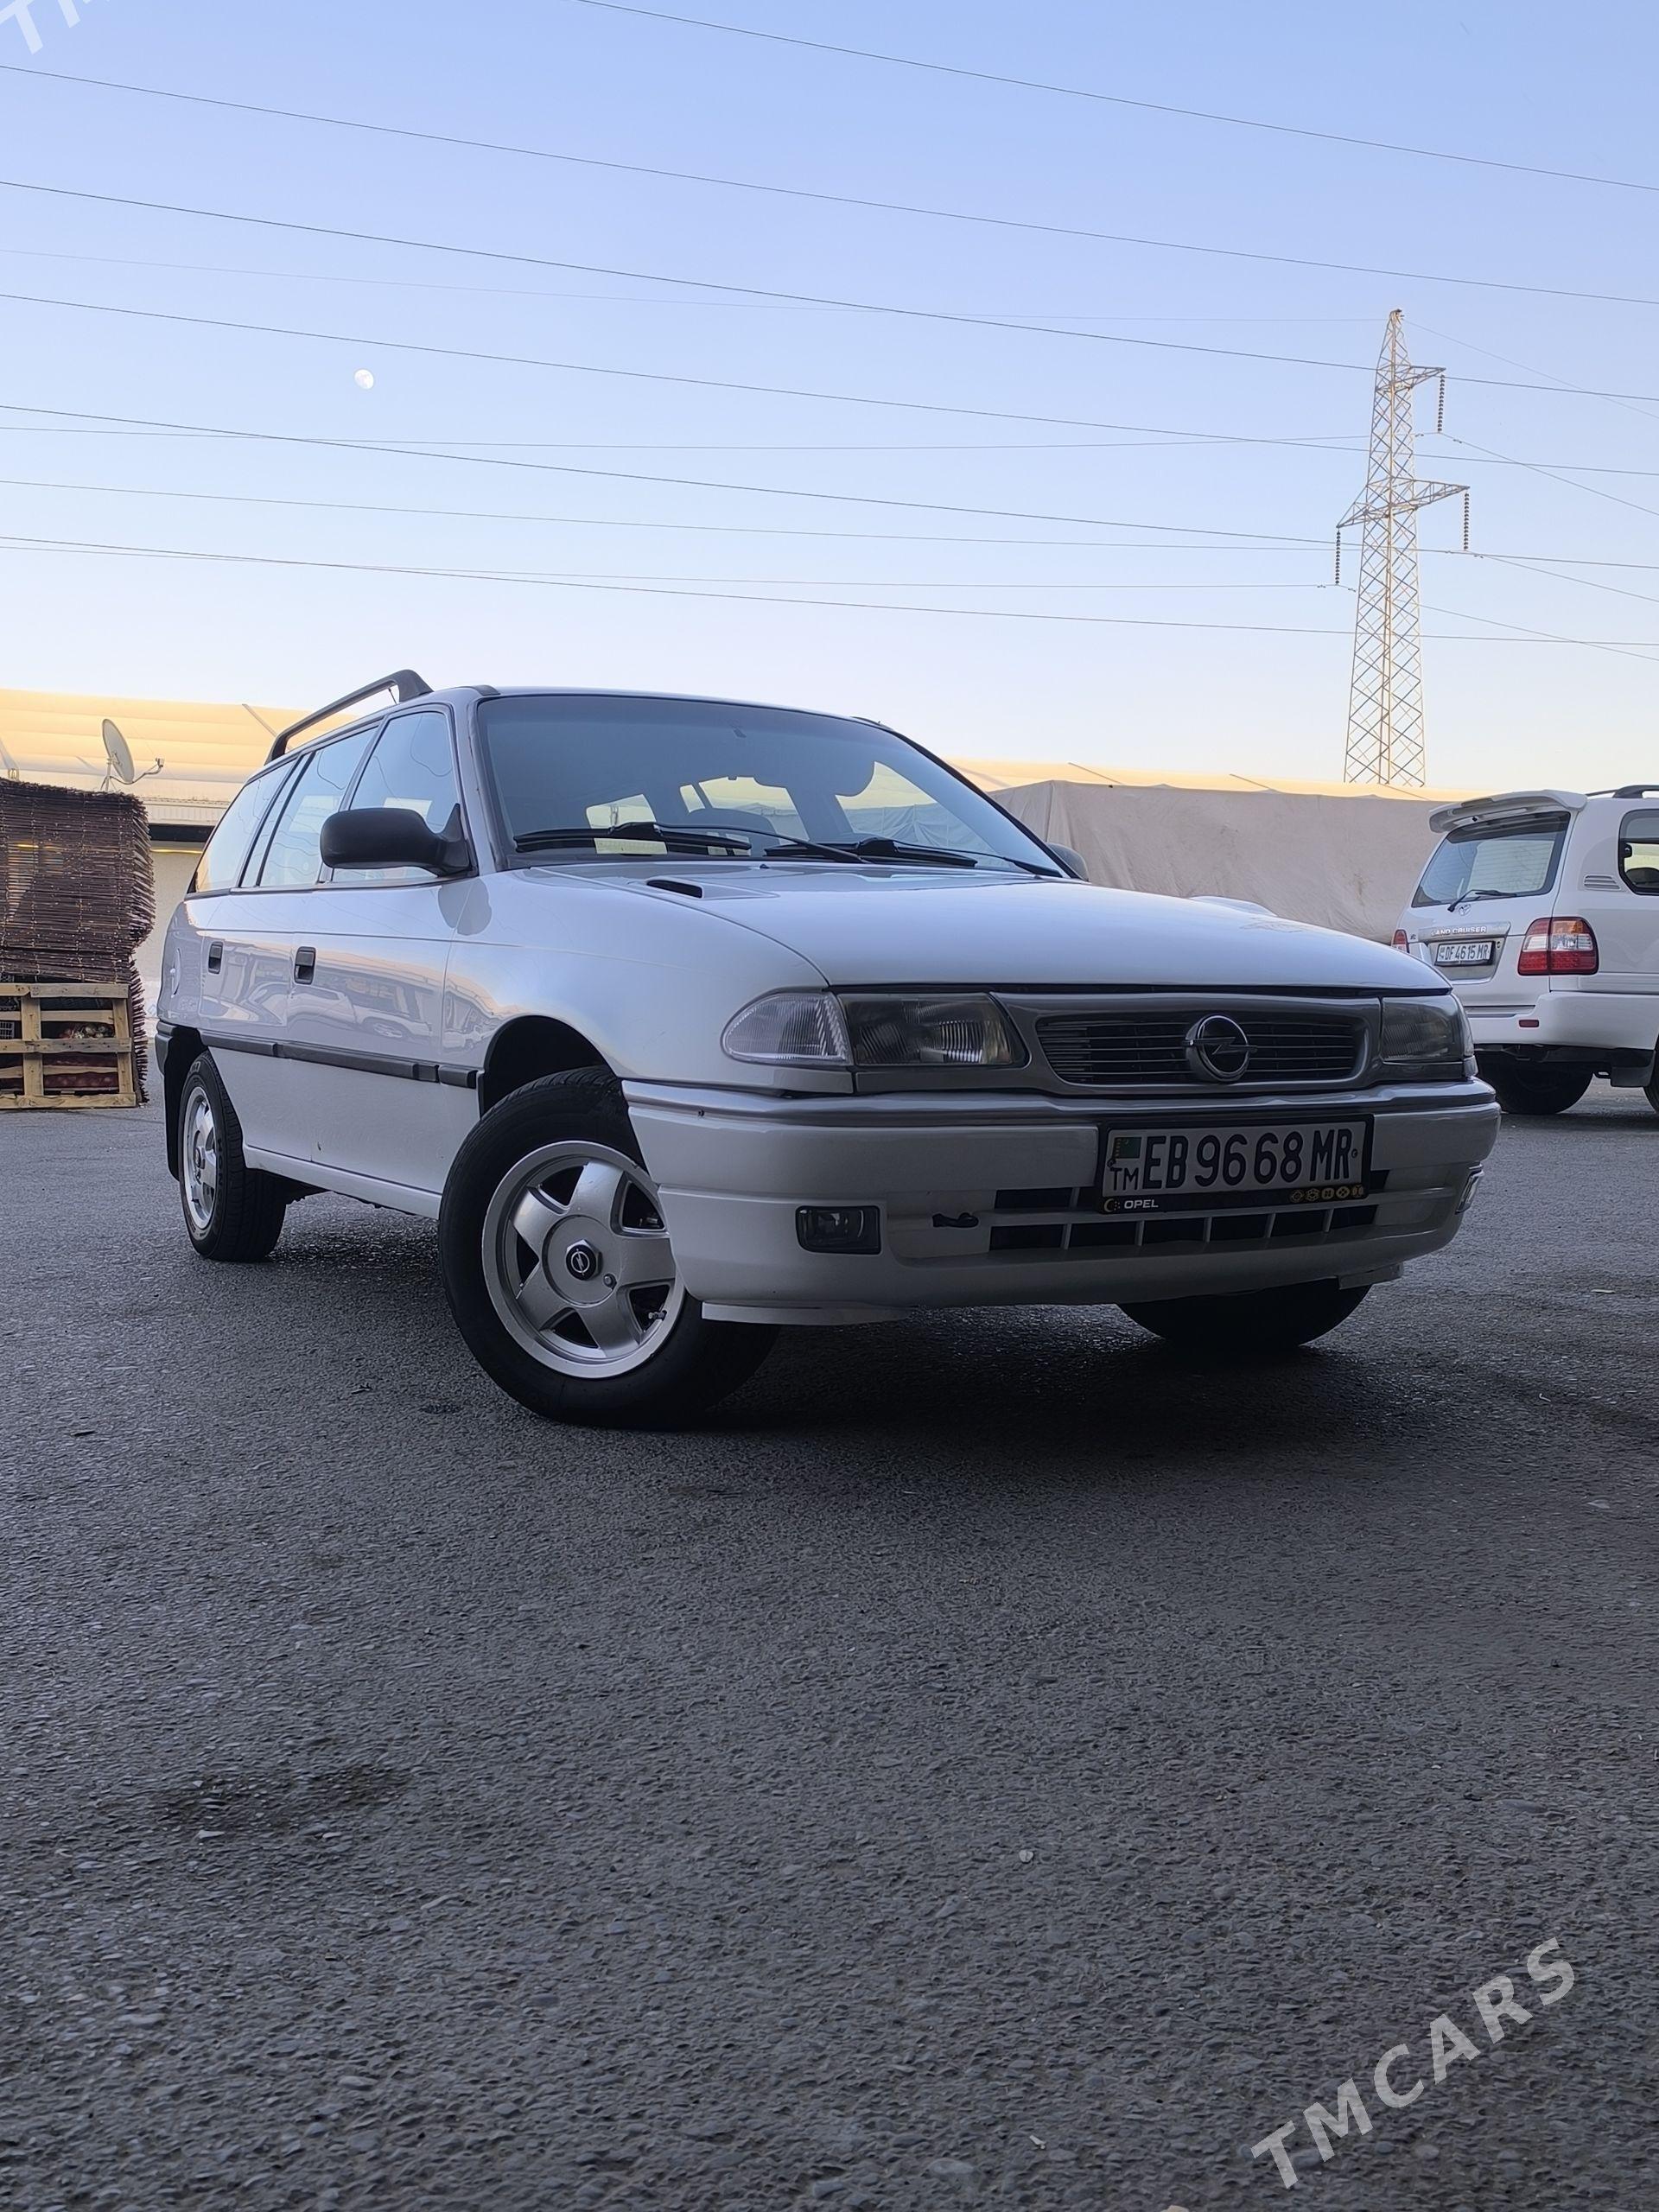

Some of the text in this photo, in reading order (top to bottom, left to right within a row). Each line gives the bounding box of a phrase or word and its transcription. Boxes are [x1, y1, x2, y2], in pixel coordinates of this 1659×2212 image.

[1452, 925, 1487, 934] CRUISER
[1109, 1167, 1140, 1192] TM
[1123, 1199, 1160, 1209] OPEL
